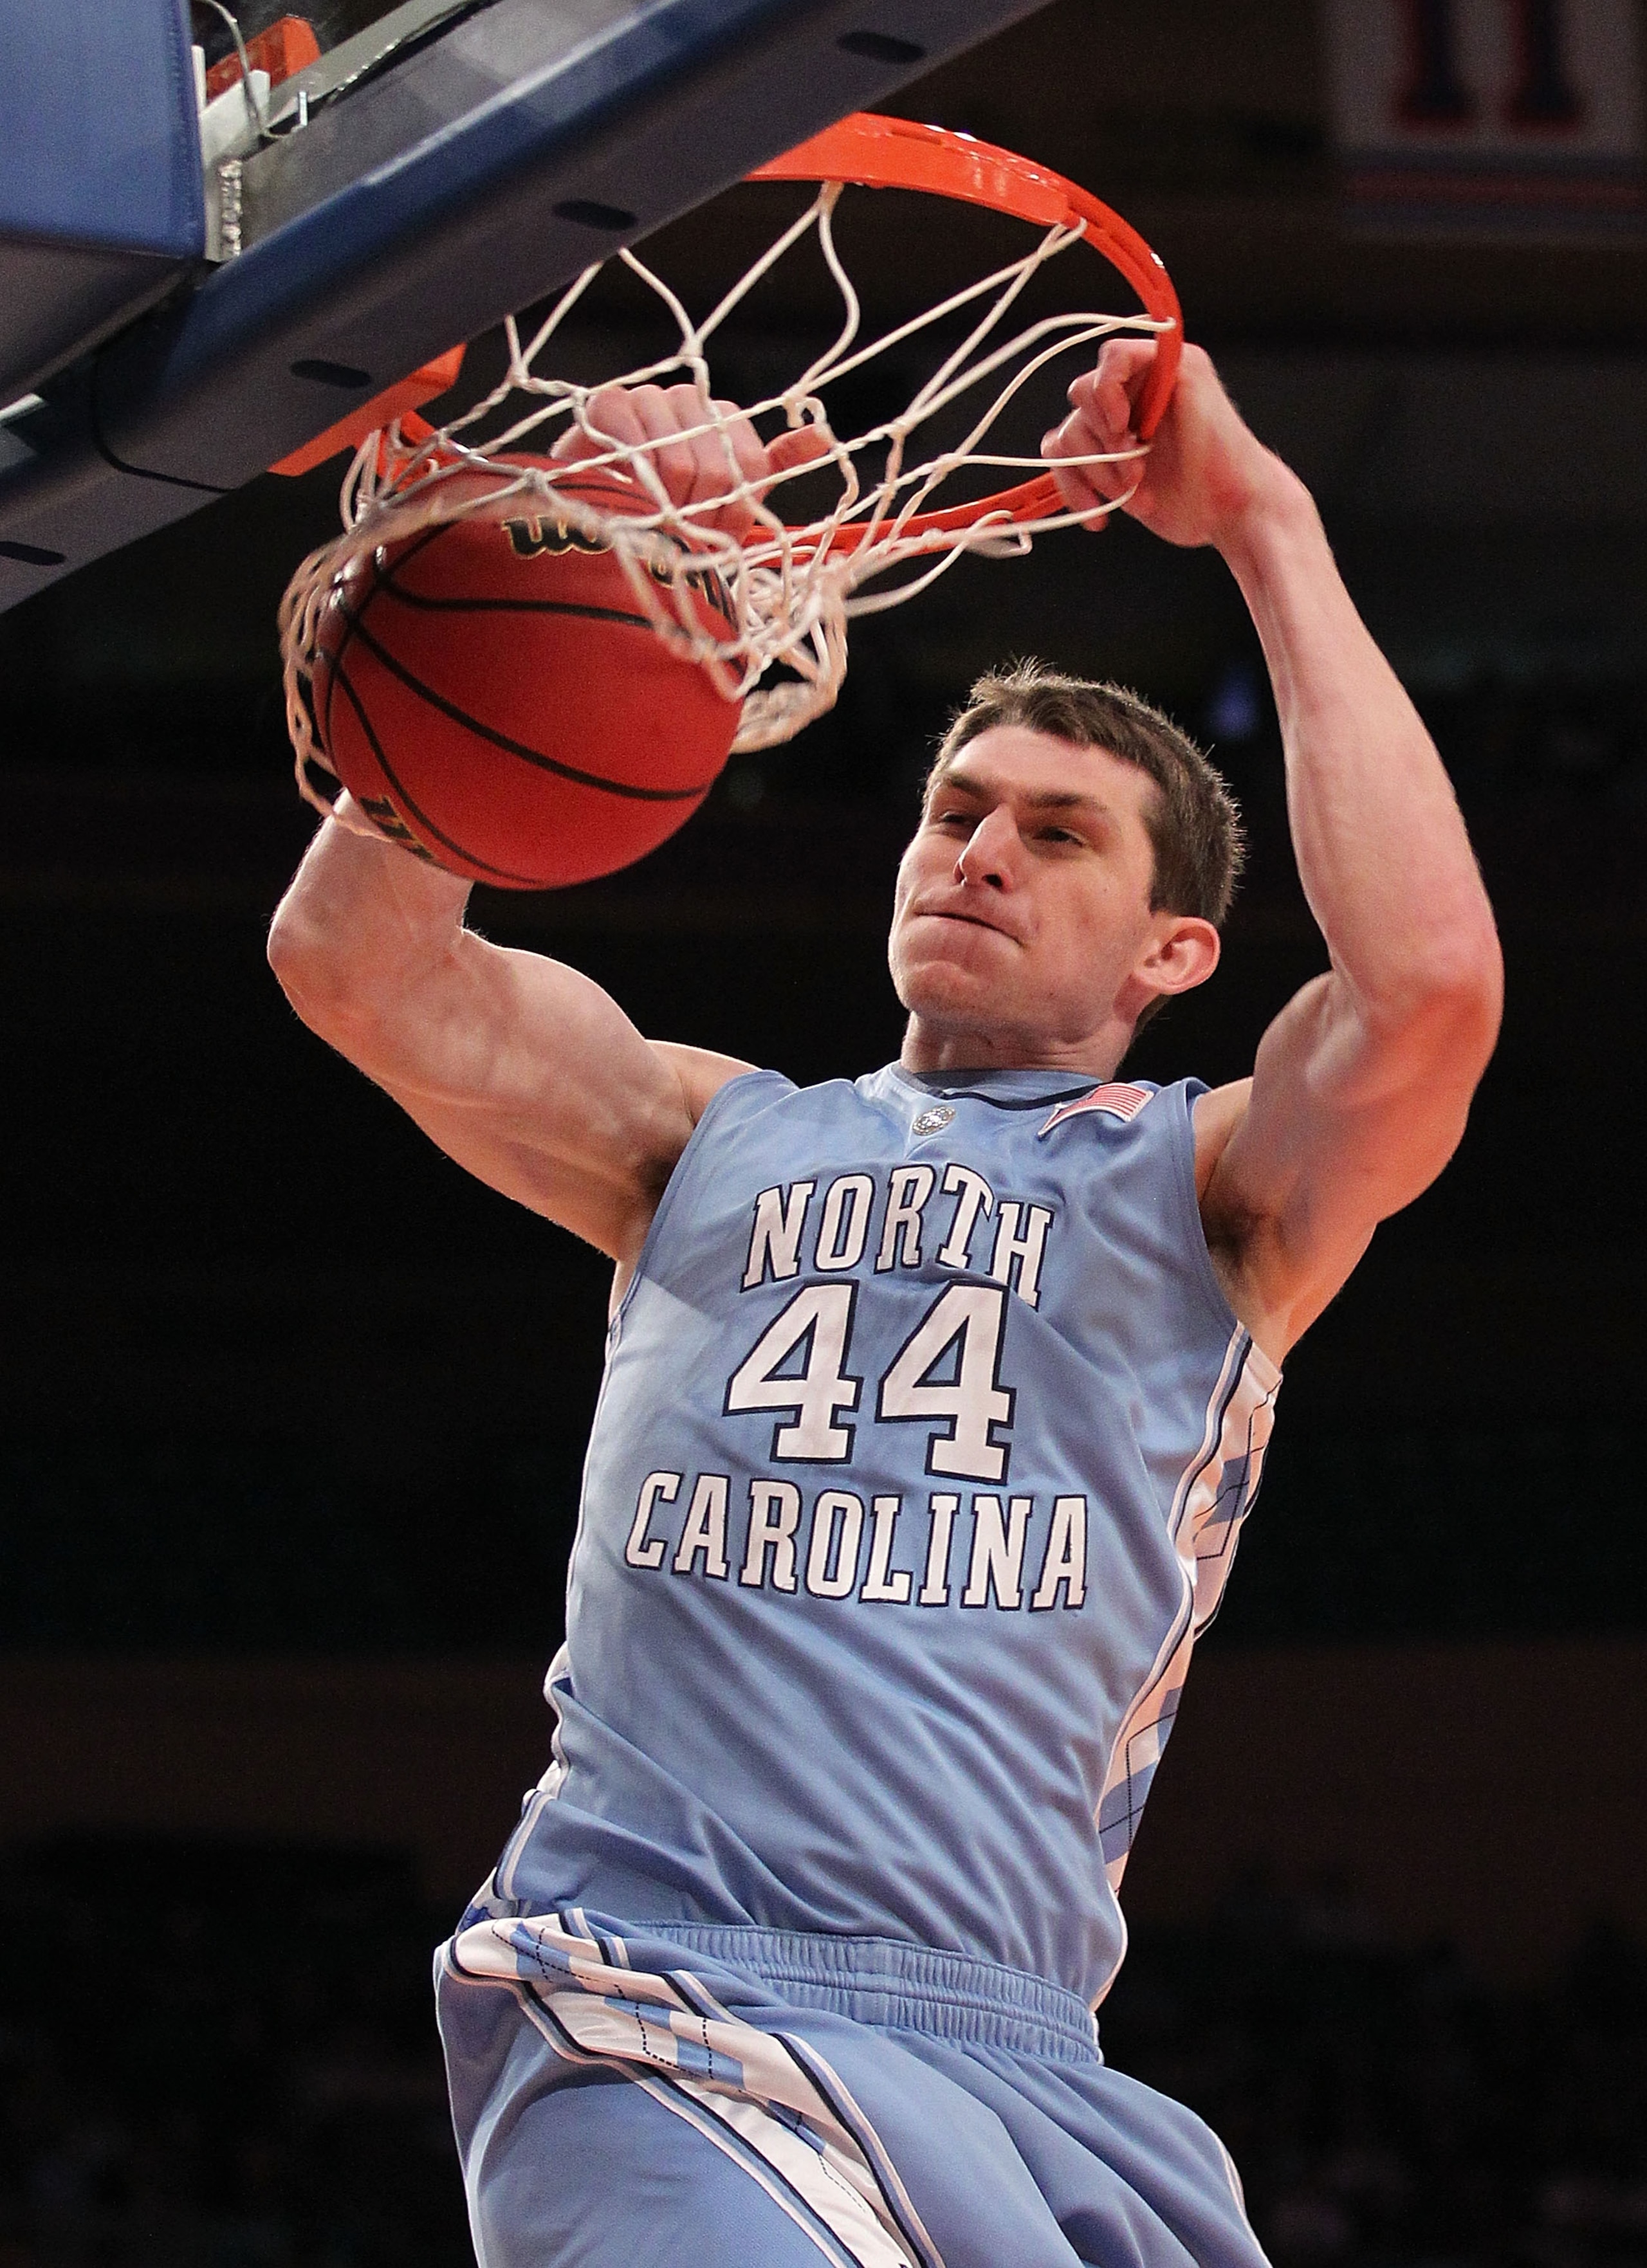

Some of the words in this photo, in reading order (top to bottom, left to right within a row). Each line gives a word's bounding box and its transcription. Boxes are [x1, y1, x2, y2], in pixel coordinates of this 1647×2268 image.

[739, 1162, 1054, 1312] NORTH
[721, 1279, 1017, 1486] 44
[624, 1470, 1089, 1612] CAROLINA
